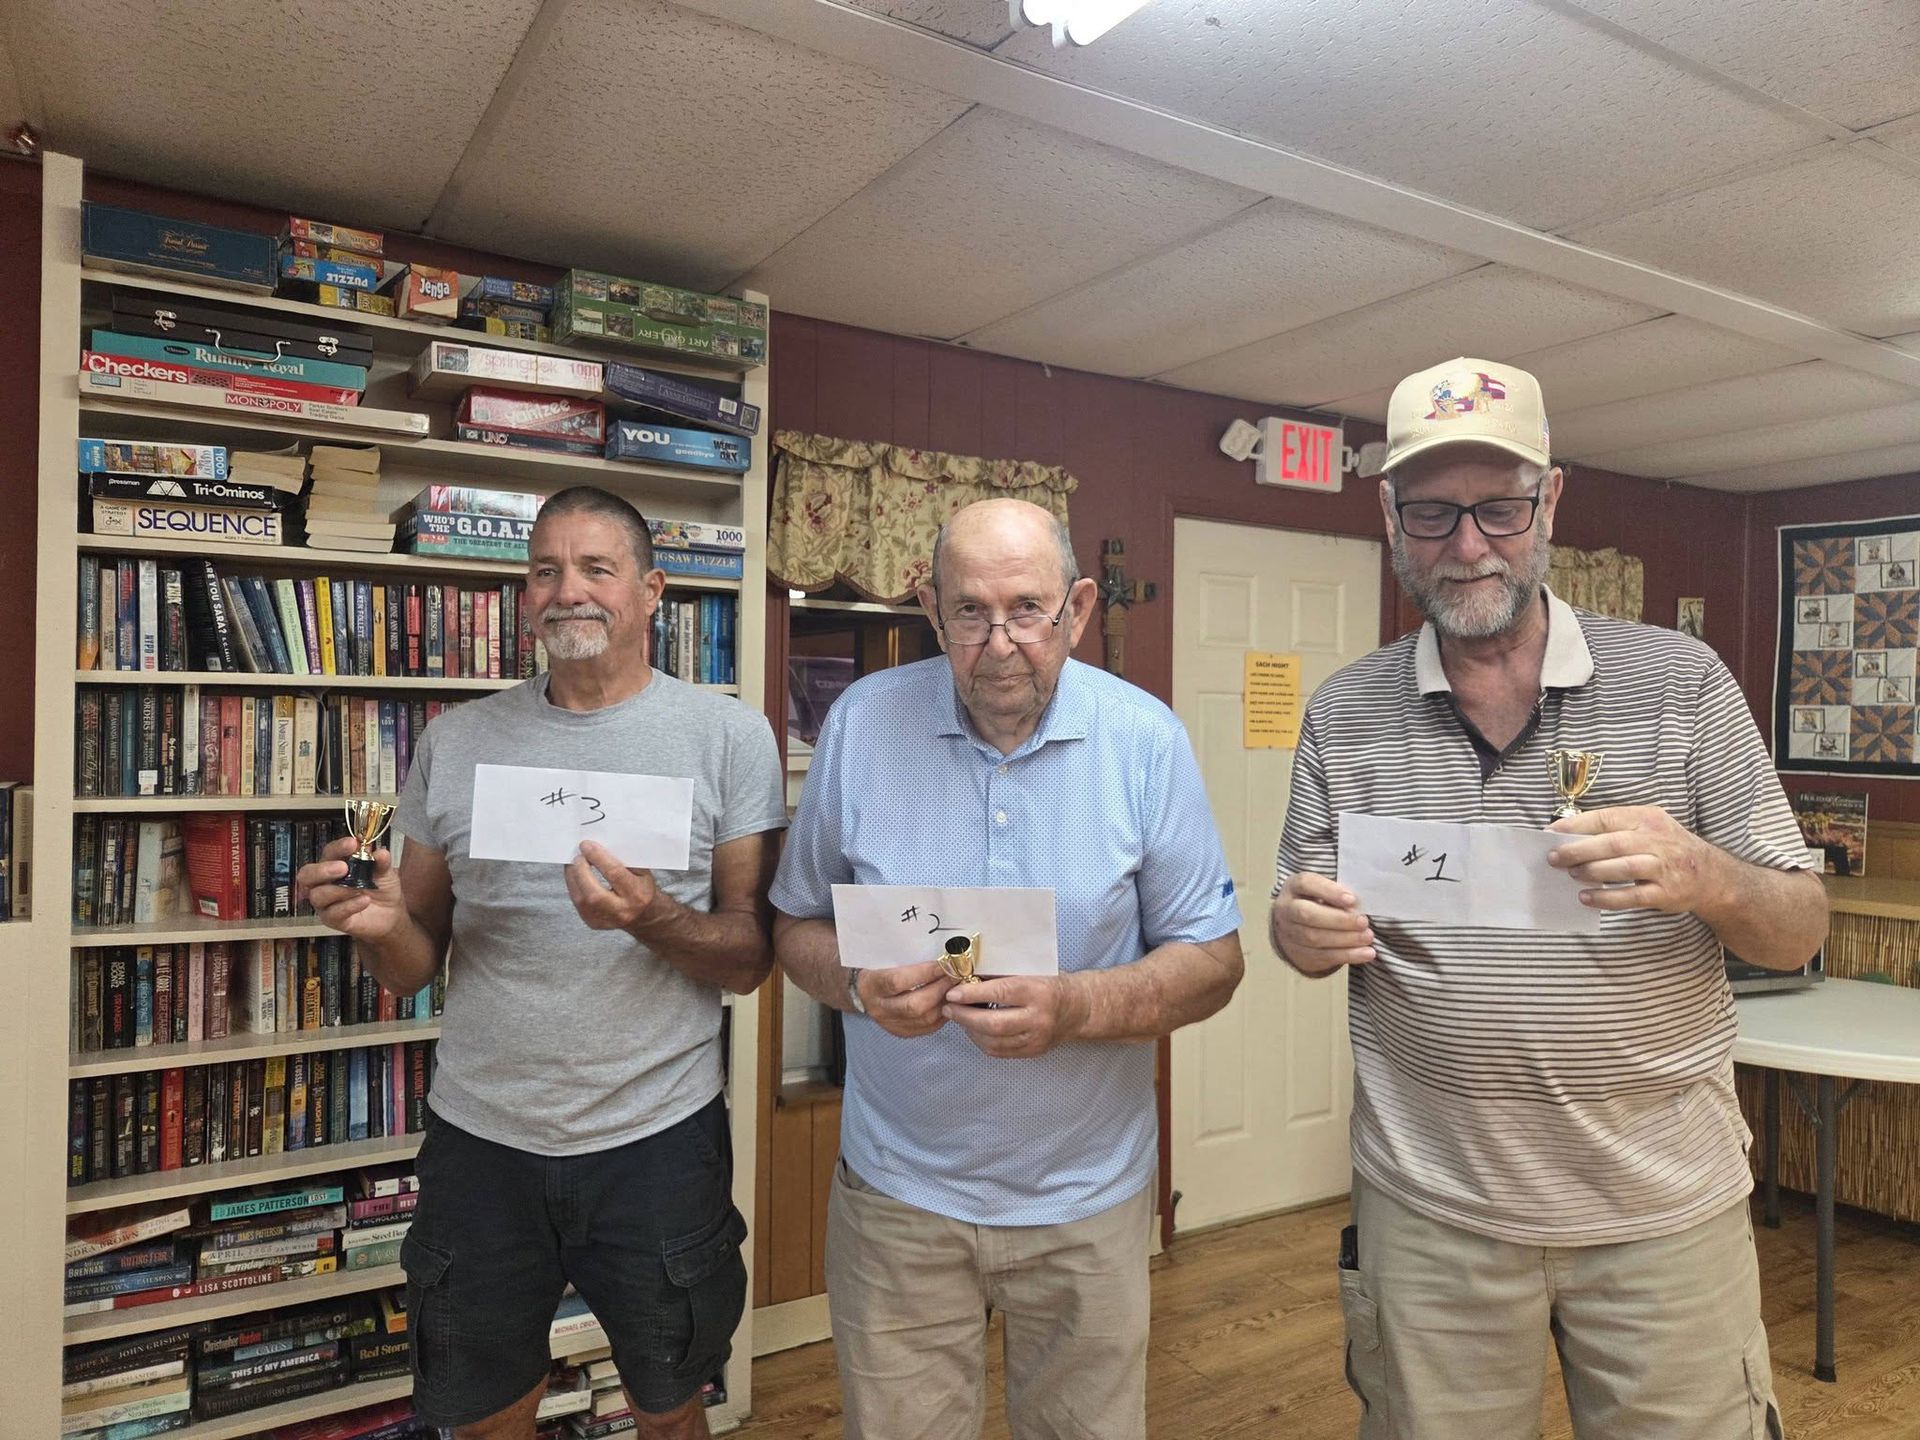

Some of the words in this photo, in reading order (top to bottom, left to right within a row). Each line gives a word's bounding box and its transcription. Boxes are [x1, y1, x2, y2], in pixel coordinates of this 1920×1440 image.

[326, 272, 369, 288] PUZZLE
[419, 277, 450, 299] Jenga
[88, 354, 188, 384] Checkers
[226, 393, 301, 413] MONOPOLY
[482, 430, 508, 445] UNO
[622, 427, 671, 445] YOU
[215, 449, 225, 476] 1000
[1281, 423, 1333, 483] EXIT
[137, 507, 276, 537] SEQUENCE
[423, 514, 456, 526] WHO'S
[429, 523, 450, 533] THE
[716, 529, 743, 542] 1000
[203, 560, 216, 579] ARE
[655, 551, 692, 564] IGSAW
[694, 555, 737, 569] PUZZLE
[208, 581, 220, 601] YOU
[356, 595, 364, 609] KEN
[213, 603, 228, 635] SARA?
[357, 610, 365, 638] FOLLETT
[143, 634, 154, 654] NYPD
[142, 697, 151, 730] ORDERS
[186, 773, 195, 793] DARK
[231, 845, 240, 877] TAYLOR
[1401, 843, 1462, 883] #1
[275, 885, 289, 912] WHITE
[900, 904, 966, 935] #2
[224, 1202, 256, 1218] JAMES
[258, 1195, 310, 1214] PATTERSON
[373, 1202, 391, 1212] THE
[362, 1214, 399, 1225] NICHOLAS
[64, 1245, 97, 1260] NDRA
[100, 1229, 140, 1249] BROWN
[208, 1249, 244, 1260] APRIL
[68, 1265, 104, 1279] BRENNAN
[199, 1283, 219, 1294] LISA
[221, 1273, 273, 1290] SCOTTOLINE
[118, 1345, 145, 1359] JOHN
[145, 1331, 190, 1350] GRISHAM
[360, 1345, 379, 1360] Red
[231, 1368, 253, 1380] THIS
[253, 1365, 263, 1375] IS
[264, 1362, 279, 1373] MY
[279, 1352, 320, 1369] AMERICA
